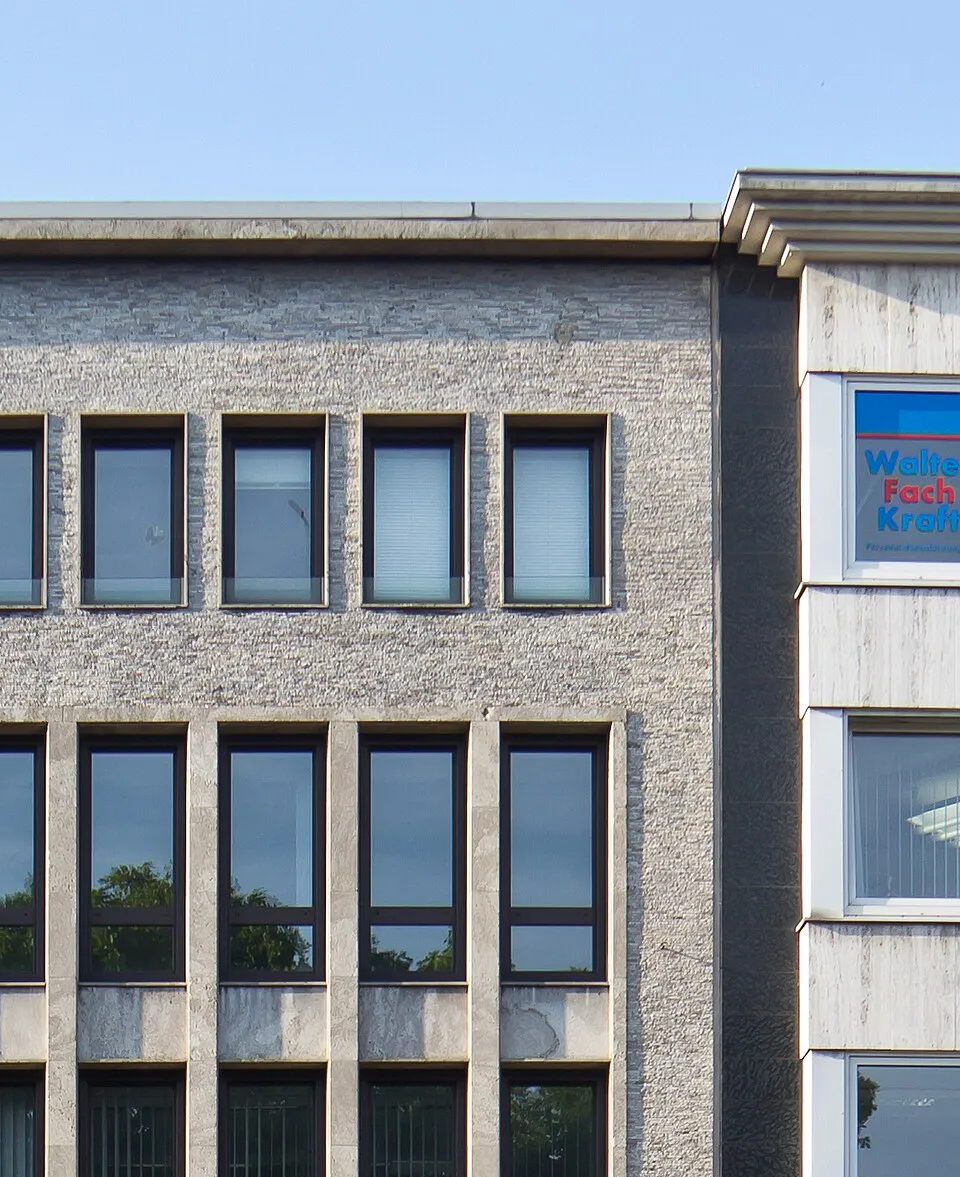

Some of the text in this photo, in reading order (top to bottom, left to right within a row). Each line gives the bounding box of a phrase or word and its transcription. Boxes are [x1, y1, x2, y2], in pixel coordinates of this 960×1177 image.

[865, 449, 960, 476] Walte
[884, 477, 955, 504] Fach
[877, 505, 960, 532] Kraft
